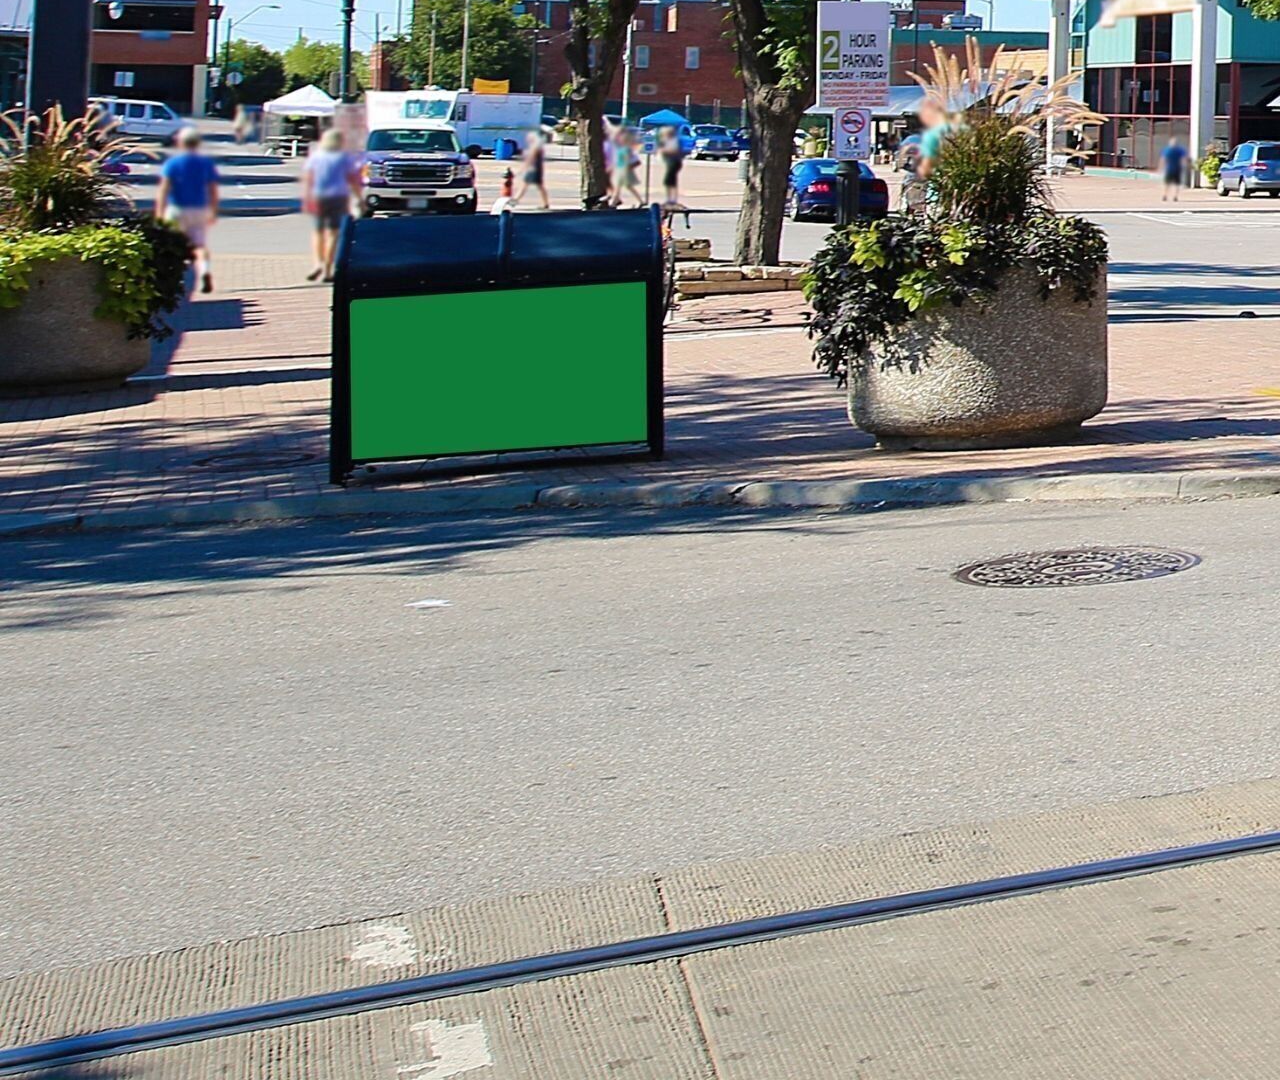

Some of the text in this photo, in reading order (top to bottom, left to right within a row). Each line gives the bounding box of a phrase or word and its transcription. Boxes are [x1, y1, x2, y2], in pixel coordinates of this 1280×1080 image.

[849, 34, 877, 48] HOUR
[823, 35, 839, 63] 2
[841, 54, 884, 68] PARKING
[820, 71, 855, 80] MONDAY
[860, 71, 889, 80] FRIDAY
